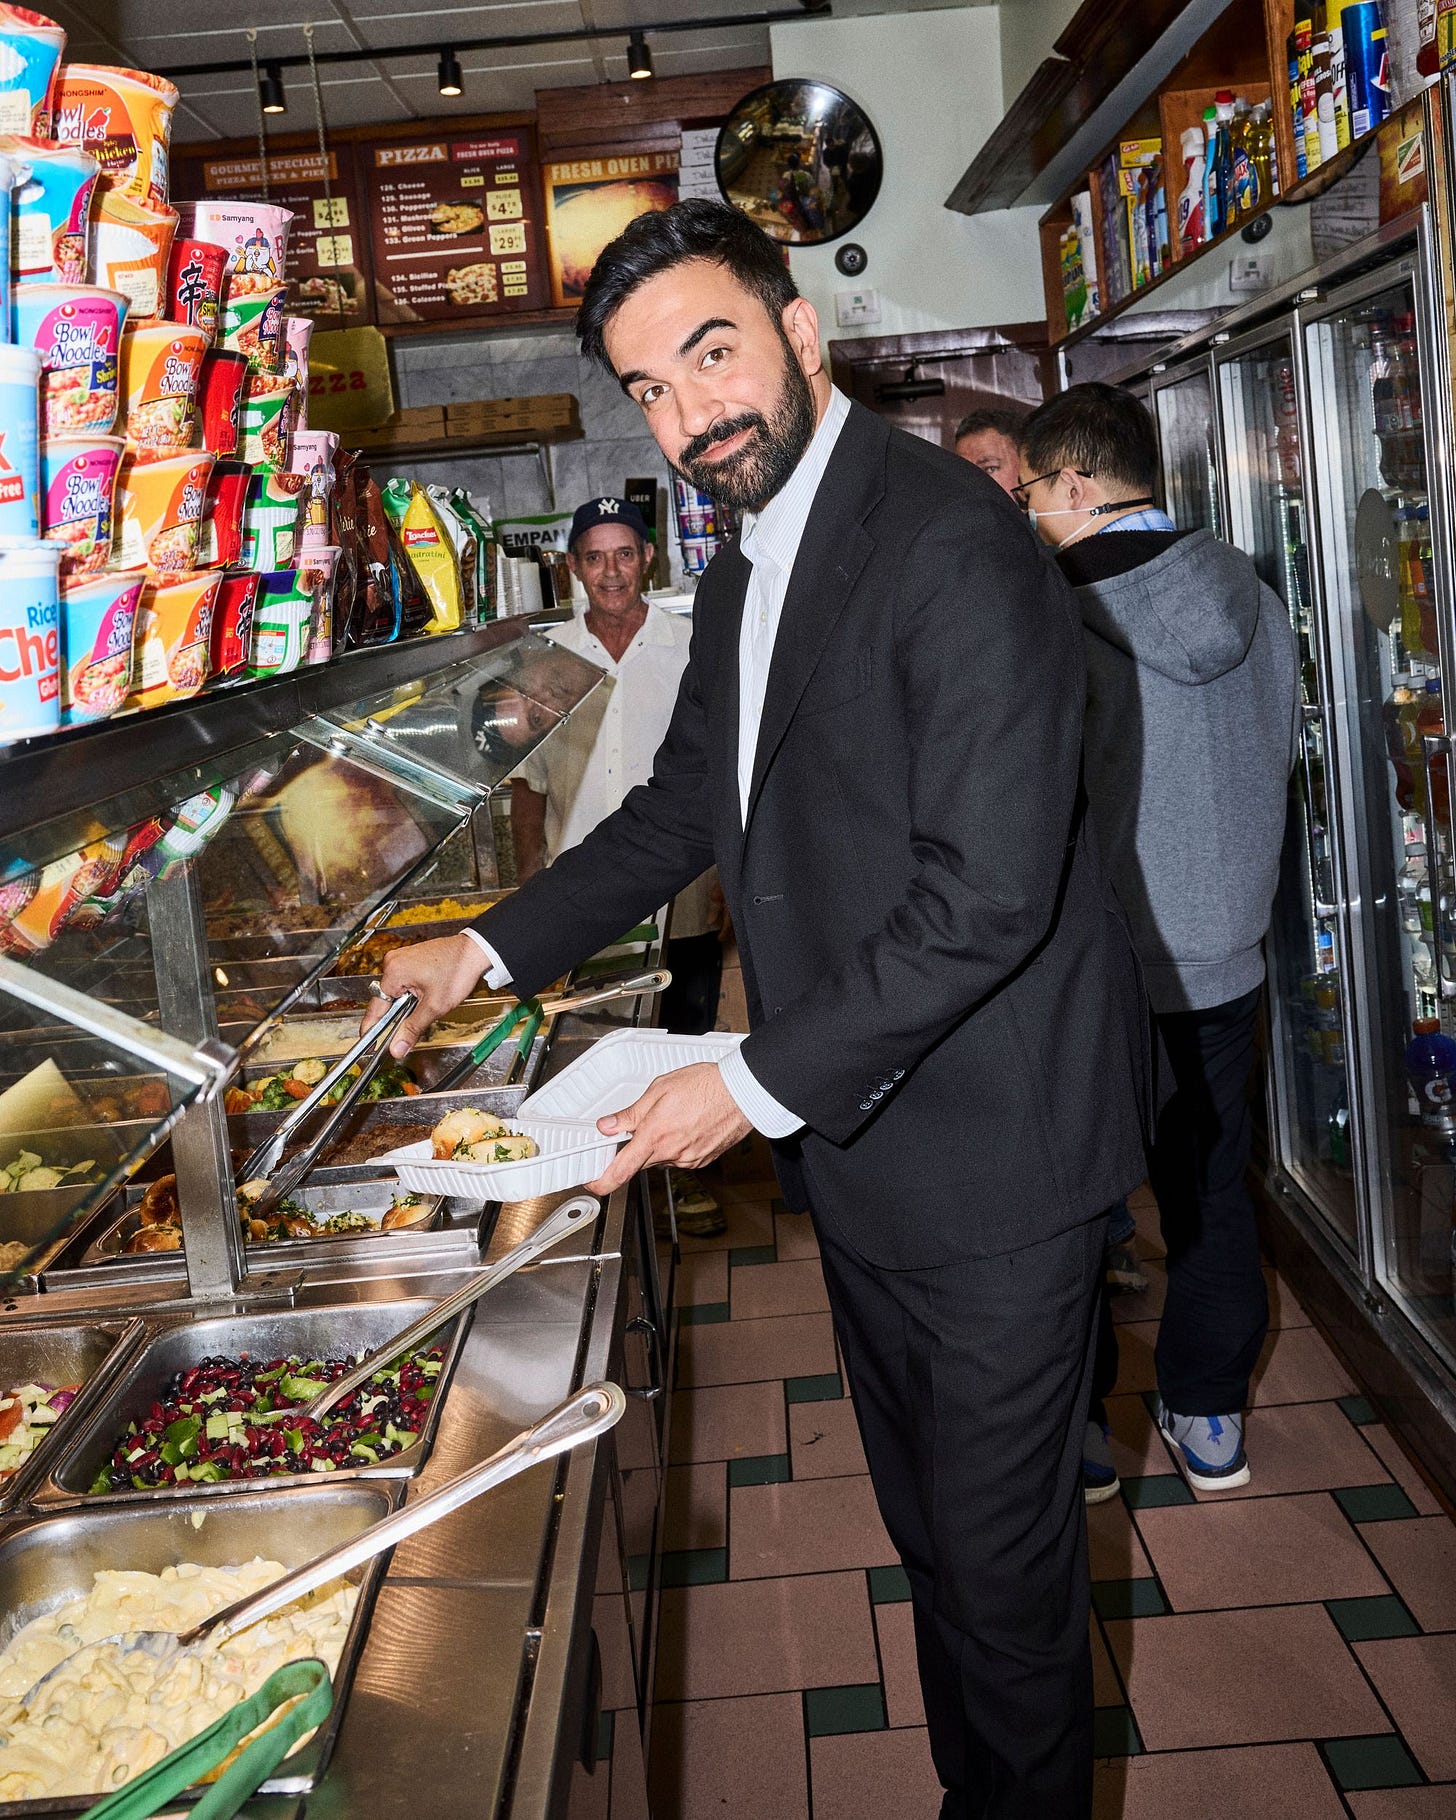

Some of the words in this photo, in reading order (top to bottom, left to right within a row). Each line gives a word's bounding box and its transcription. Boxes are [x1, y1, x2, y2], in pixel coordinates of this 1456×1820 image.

[60, 89, 105, 97] NONGSHIM
[379, 146, 445, 164] PIZZA
[551, 161, 603, 181] FRESH
[607, 156, 650, 175] OVEN
[397, 182, 425, 190] Cheese
[399, 193, 431, 201] Sausage
[400, 203, 437, 211] Pepperoni
[222, 214, 254, 223] Samyang
[402, 225, 425, 233] Olives
[426, 232, 458, 241] Peppers
[178, 262, 207, 326] 辛
[55, 322, 96, 343] Bowl
[50, 341, 106, 367] Noodles
[68, 475, 101, 495] Bowl
[630, 494, 650, 502] UBER
[597, 498, 620, 515] NY
[26, 602, 57, 628] Rice
